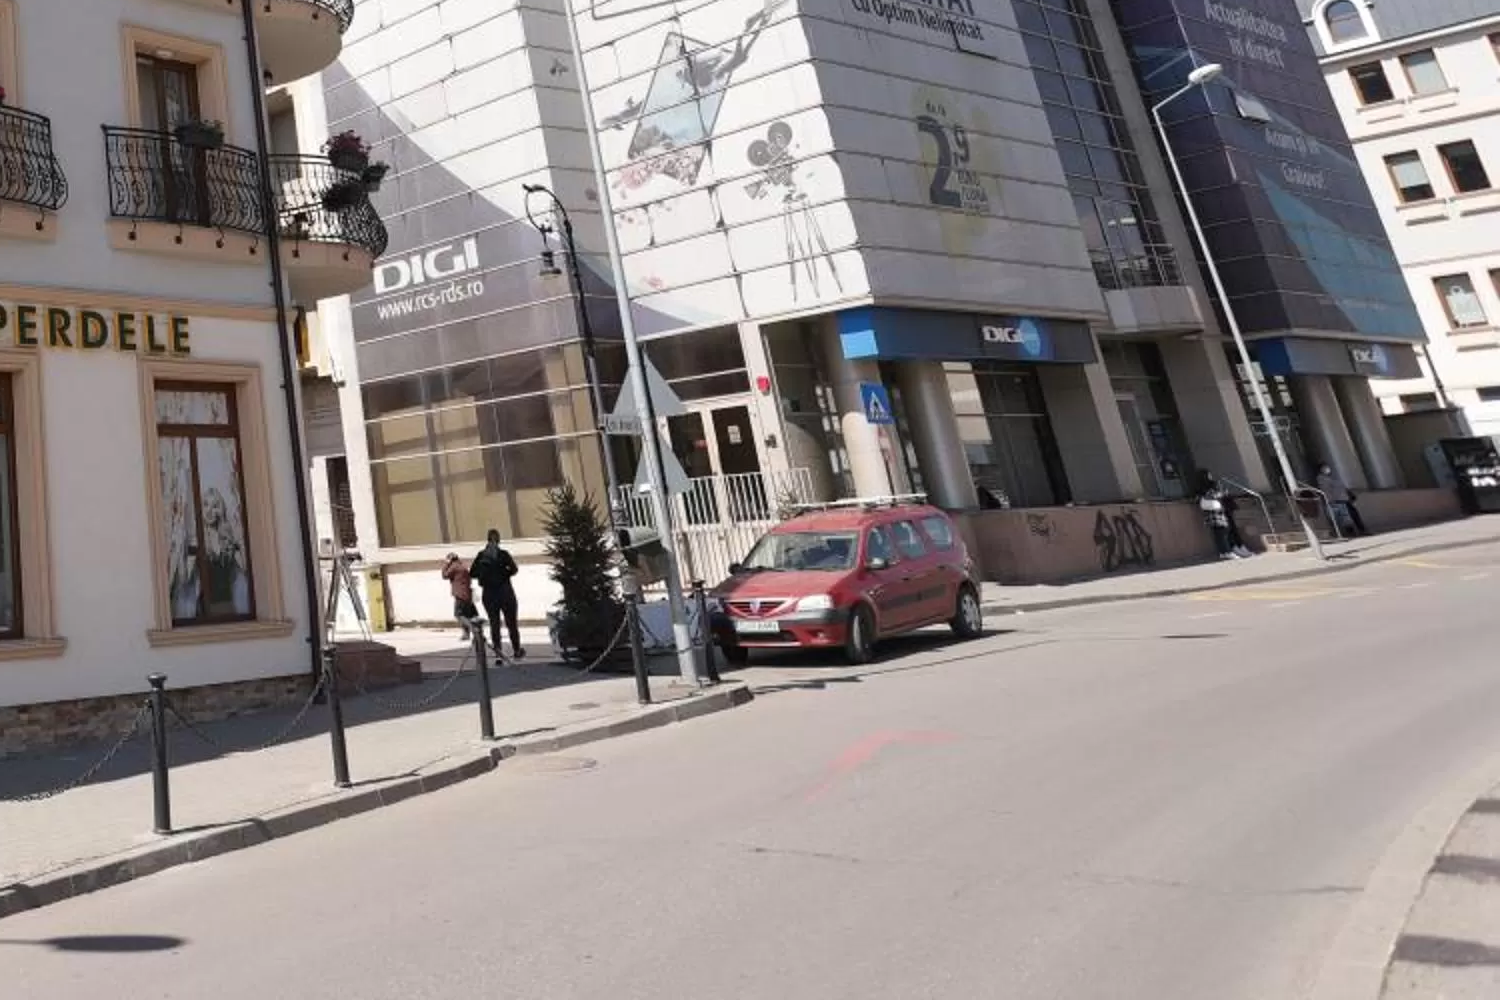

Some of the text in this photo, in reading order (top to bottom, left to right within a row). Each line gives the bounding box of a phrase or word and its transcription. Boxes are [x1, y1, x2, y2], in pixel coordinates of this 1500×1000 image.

[373, 236, 480, 295] DIGI
[377, 280, 485, 321] www.rcs-rds.ro
[982, 325, 1026, 344] DIGI
